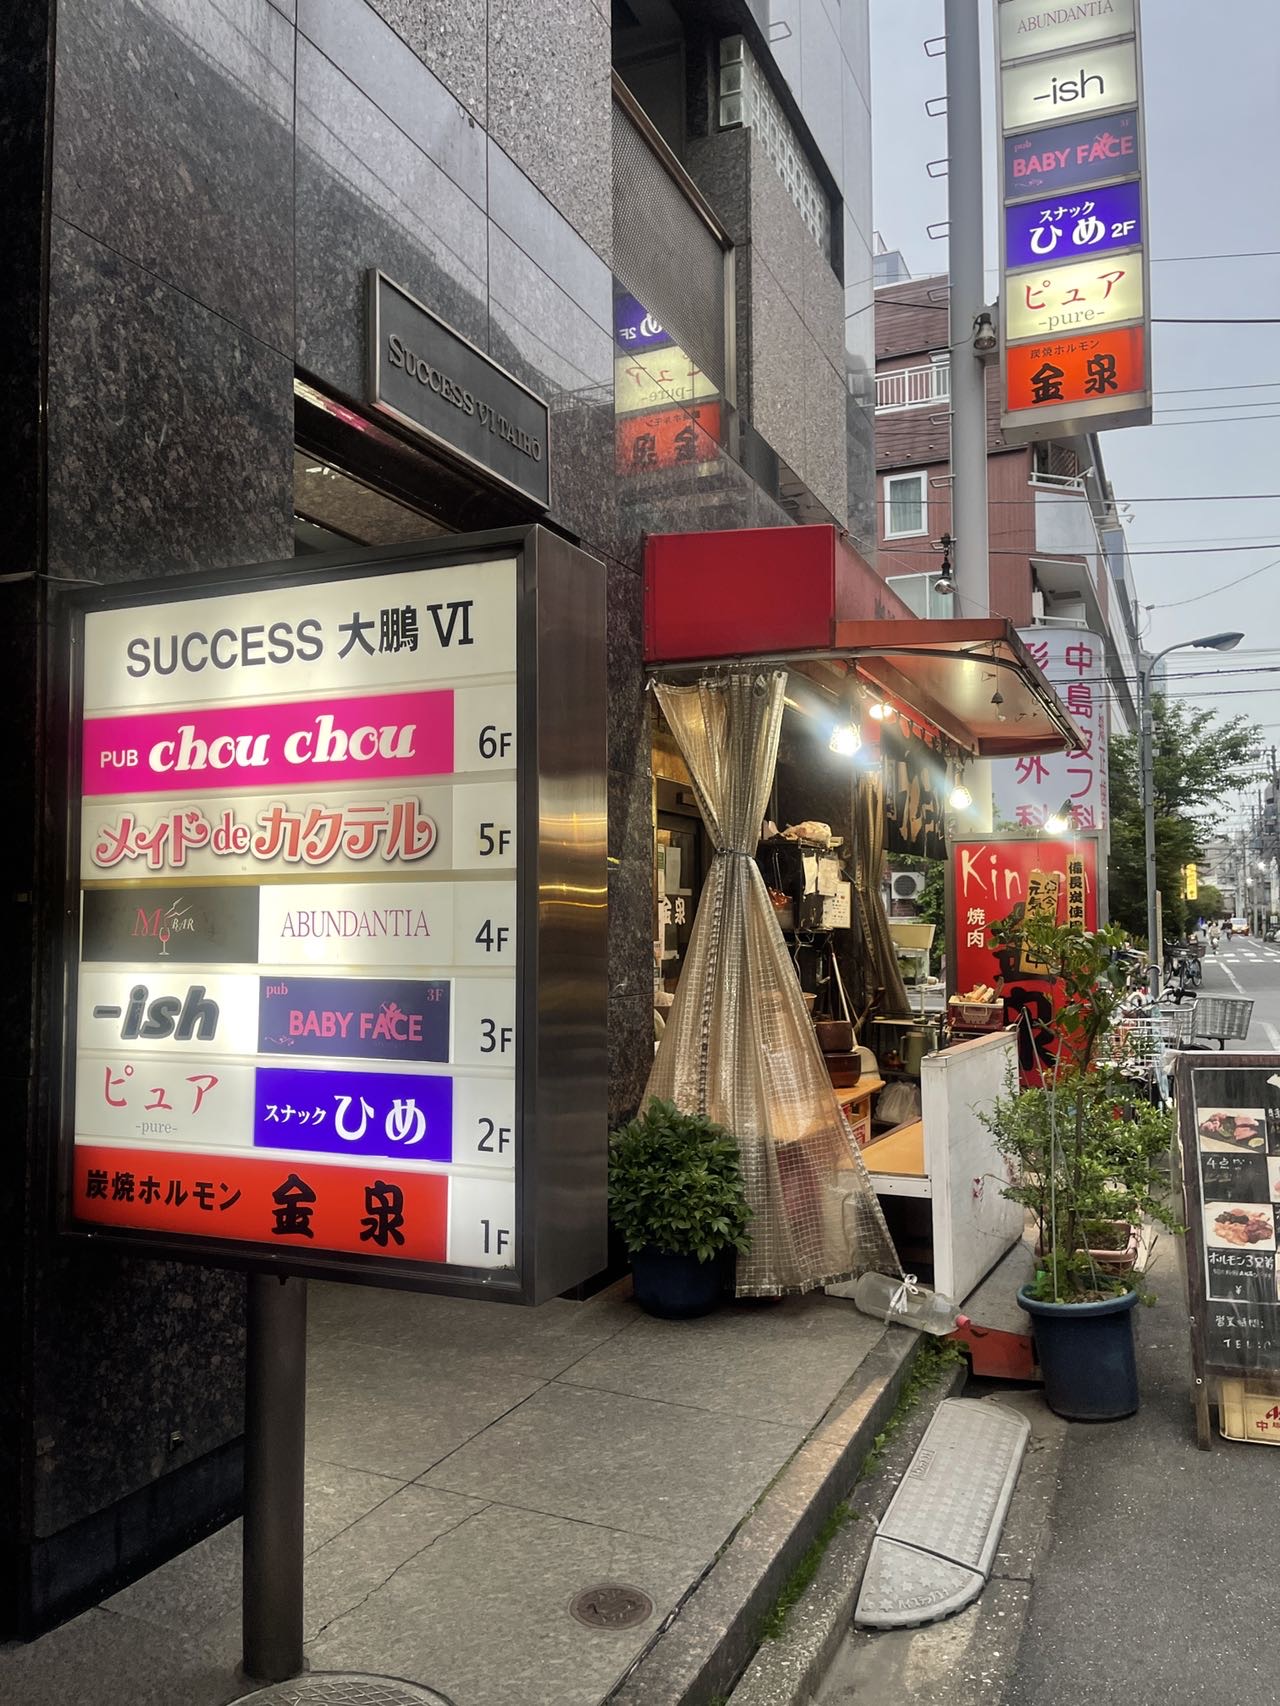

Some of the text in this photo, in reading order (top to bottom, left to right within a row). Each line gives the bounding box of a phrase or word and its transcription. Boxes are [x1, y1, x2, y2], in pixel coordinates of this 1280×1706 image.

[1017, 0, 1114, 33] ABUNDANTIA
[1033, 69, 1104, 105] -ish
[1013, 135, 1134, 177] BABY FACE
[1039, 201, 1095, 223] スナック
[1029, 216, 1136, 255] ひめ 2F
[1026, 271, 1126, 310] ピュア
[1030, 339, 1100, 359] 炭焼ホルモン
[1030, 354, 1118, 404] 金泉
[126, 619, 324, 678] SUCCESS
[337, 604, 419, 660] 大鵬
[100, 714, 417, 772] PUB chou chou
[478, 725, 512, 759] 6F
[479, 822, 512, 857] 5F
[172, 917, 195, 933] BAR
[280, 910, 431, 938] ABUNDANTIA
[475, 919, 509, 953] 4F
[967, 907, 986, 948] 焼肉
[266, 983, 289, 998] pub
[427, 988, 444, 1002] 3F
[93, 985, 220, 1041] -ish
[289, 1010, 423, 1041] BABY FACE
[480, 1018, 513, 1053] 3F
[105, 1064, 219, 1115] ピュア
[135, 1120, 178, 1137] -pure-
[264, 1094, 427, 1145] スナック ひめ
[478, 1118, 511, 1153] 2F
[86, 1169, 406, 1247] 炭焼ホルモン 金泉
[480, 1220, 509, 1255] 1F
